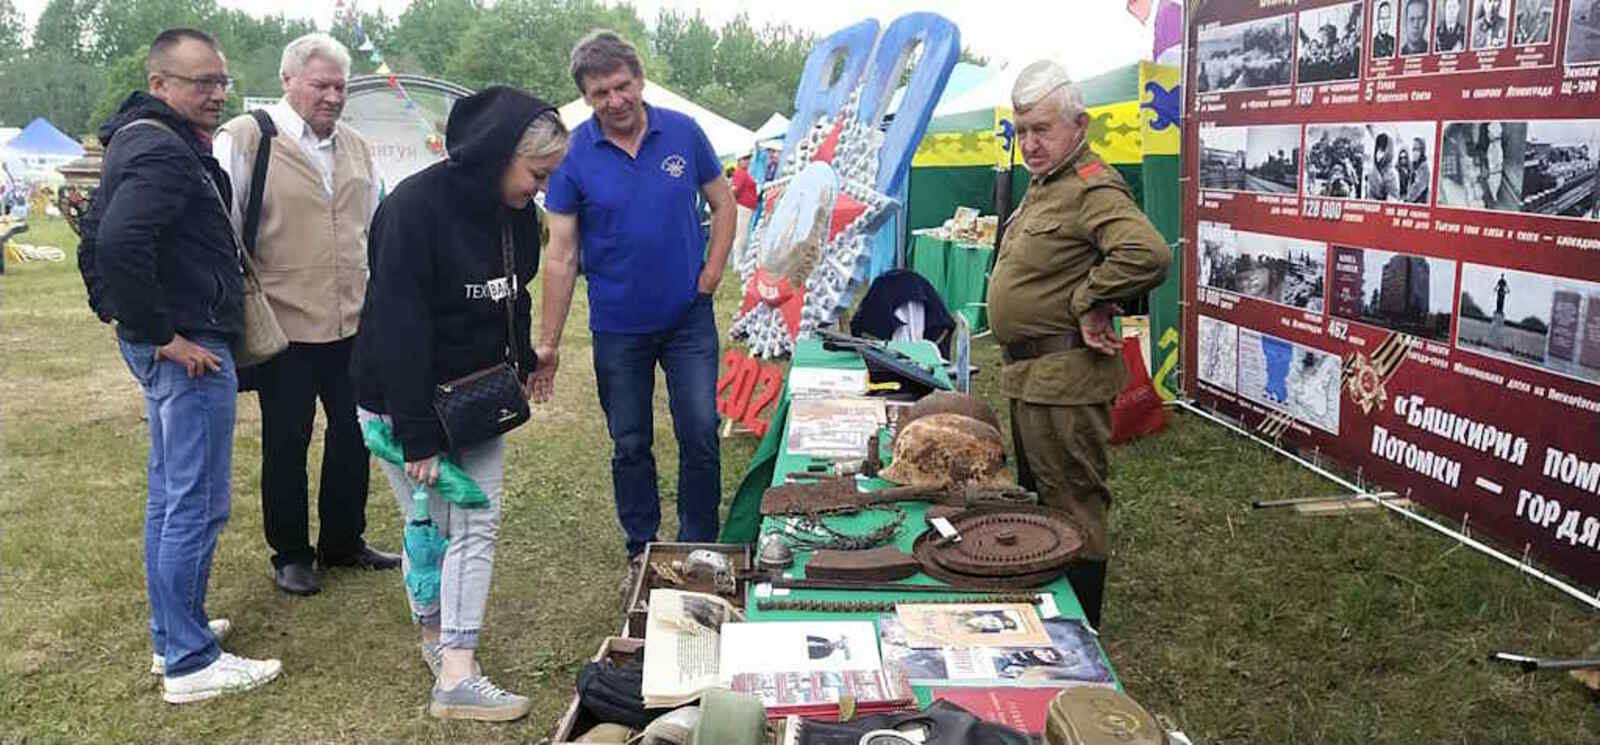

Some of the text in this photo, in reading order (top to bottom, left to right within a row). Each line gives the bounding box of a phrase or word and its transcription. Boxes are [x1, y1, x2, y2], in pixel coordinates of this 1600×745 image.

[1365, 80, 1374, 101] 5
[1322, 200, 1342, 219] 000
[1328, 319, 1348, 341] 462
[1543, 447, 1600, 496] ПОМ
[1515, 488, 1600, 551] ГОРДЯ
